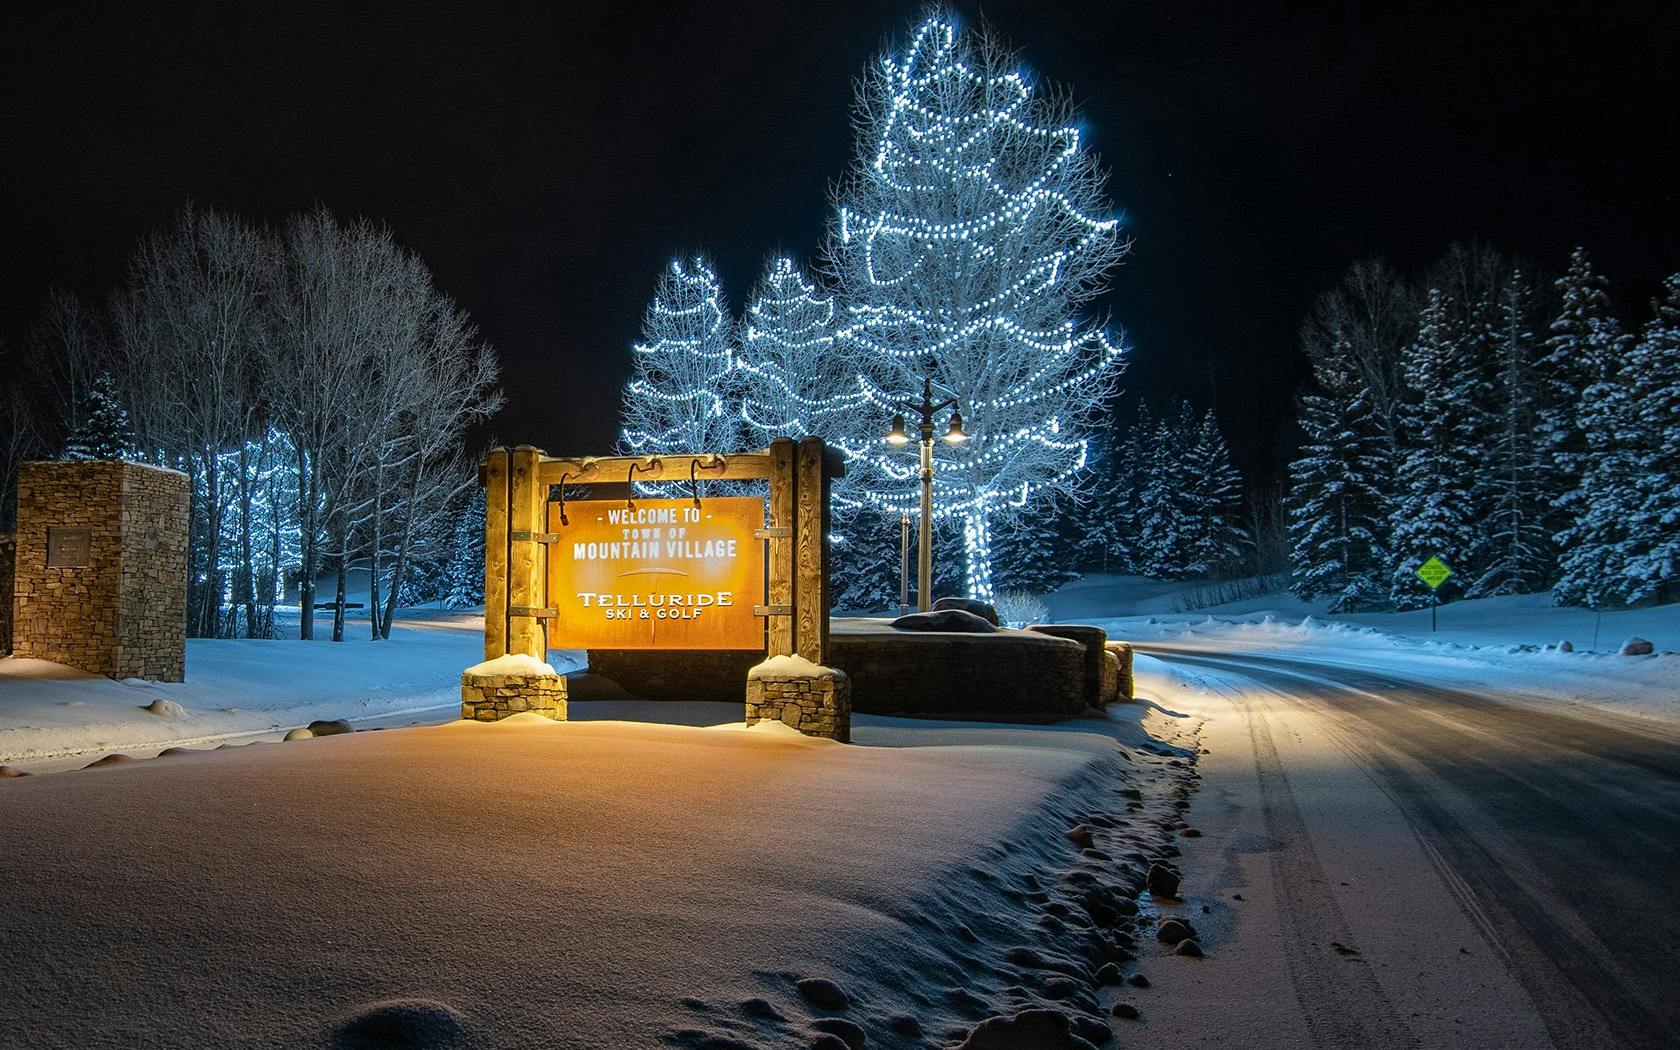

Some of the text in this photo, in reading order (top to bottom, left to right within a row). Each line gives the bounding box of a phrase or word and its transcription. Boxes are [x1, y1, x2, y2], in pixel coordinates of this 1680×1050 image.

[608, 508, 677, 524] WELCOME
[683, 508, 701, 523] TO
[623, 528, 686, 540] TOWN OF
[573, 540, 737, 560] MOUNTAIN VILLAGE
[605, 609, 702, 619] SKI & GOLF
